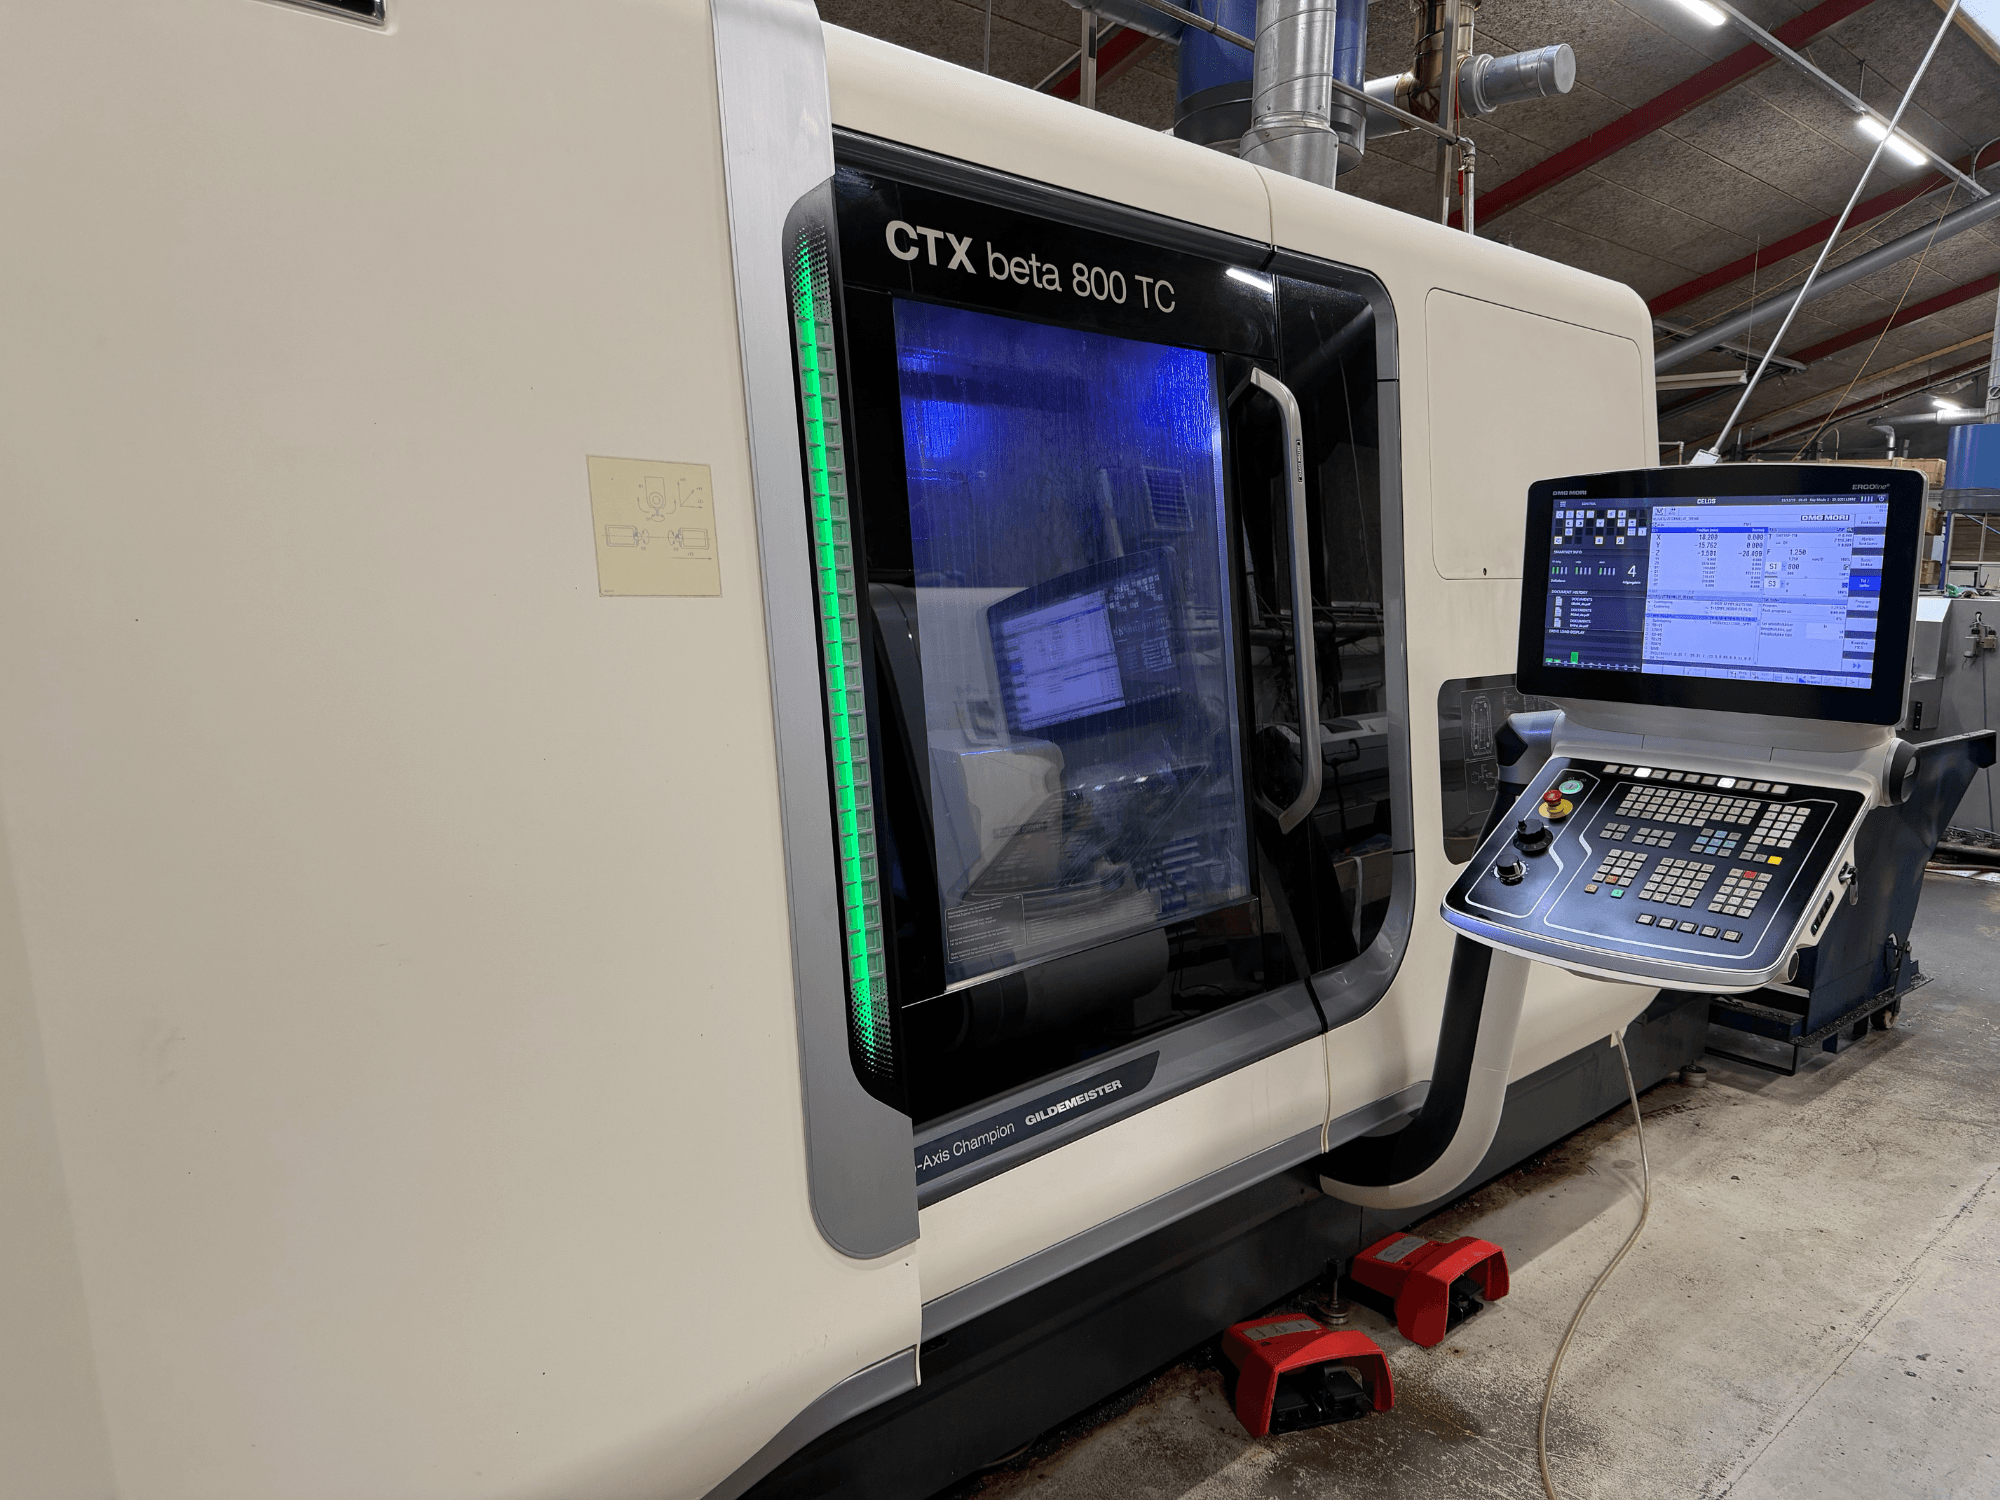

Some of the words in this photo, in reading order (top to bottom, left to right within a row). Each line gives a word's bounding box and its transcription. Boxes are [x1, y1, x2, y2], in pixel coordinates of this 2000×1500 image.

[885, 219, 977, 275] CTX
[986, 241, 1062, 292] beta
[1072, 262, 1128, 305] 800
[1134, 274, 1176, 314] TC
[1627, 565, 1637, 577] 4
[914, 1149, 951, 1173] -Axis
[952, 1121, 1016, 1157] Champion
[1025, 1079, 1123, 1126] GILDEMEISTER
